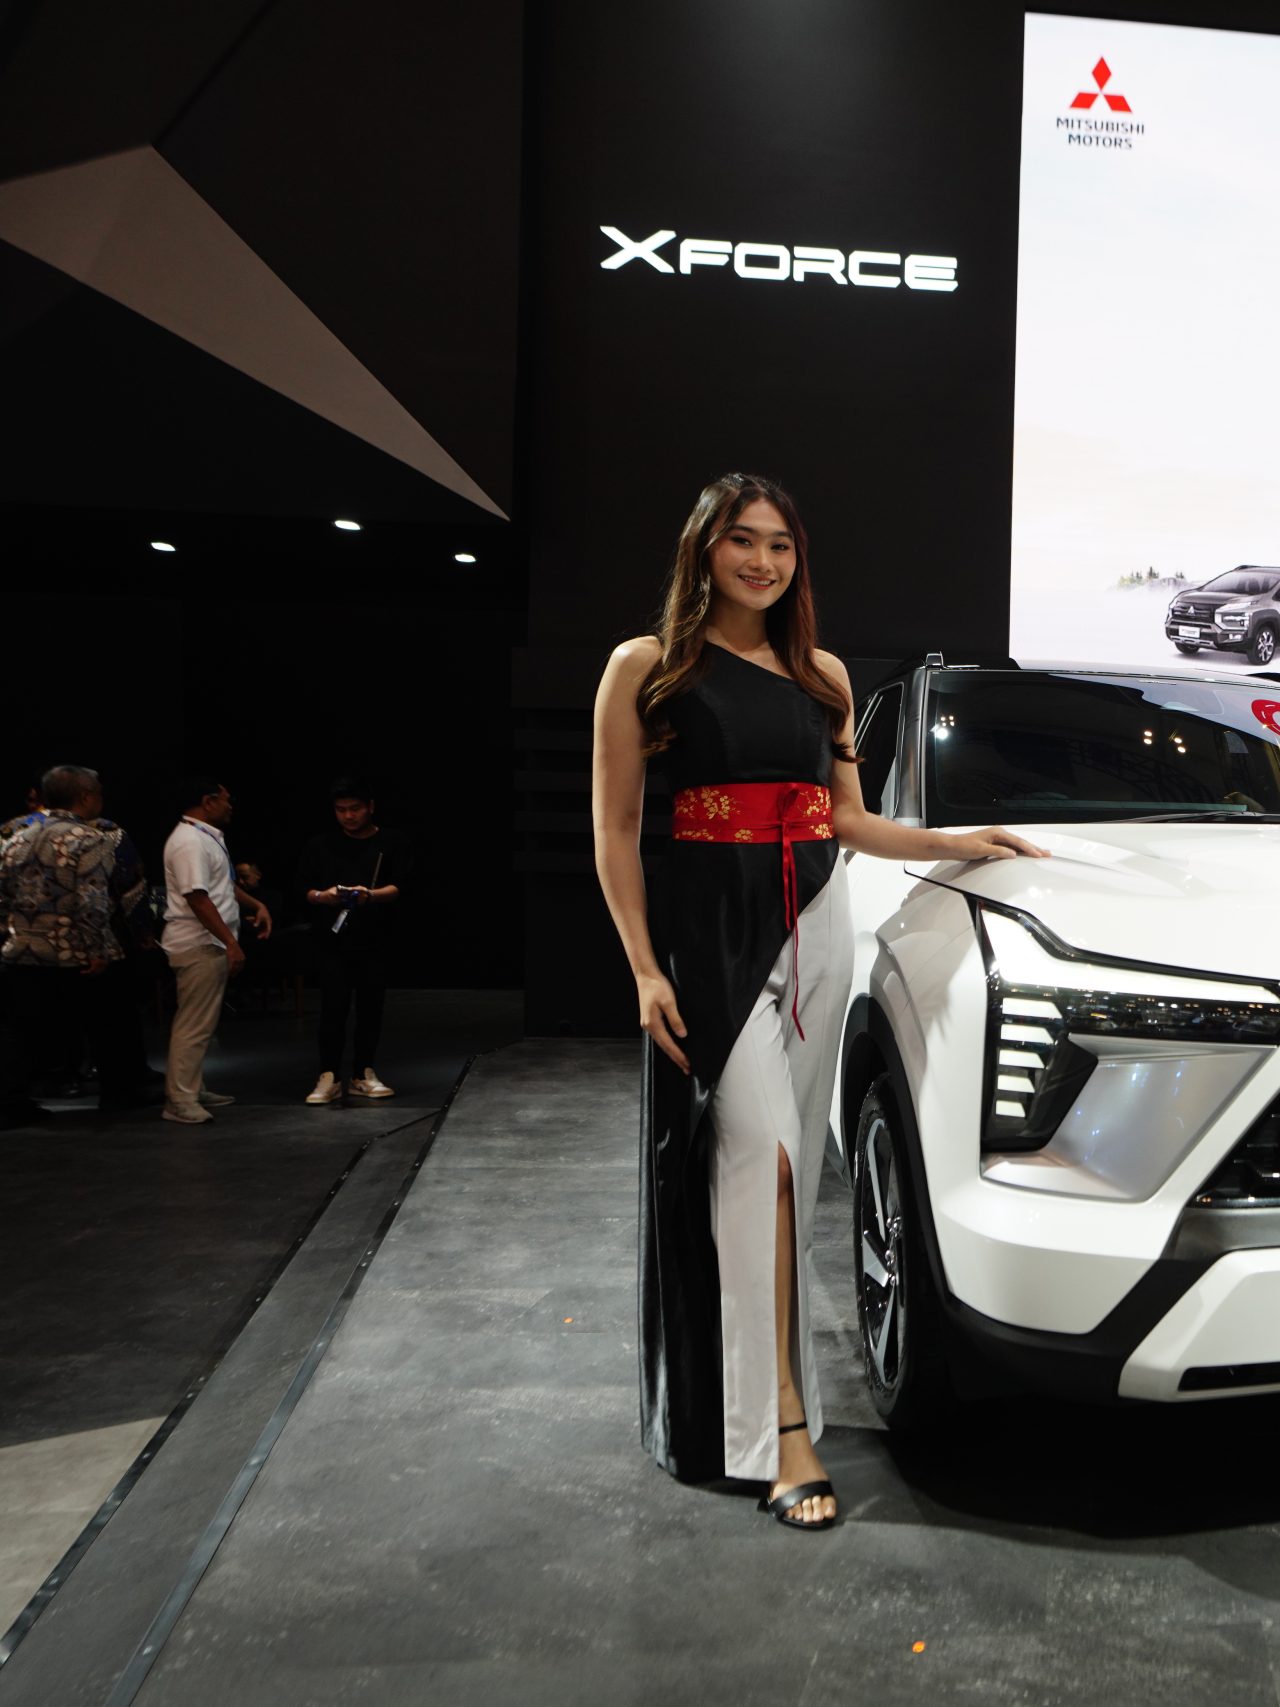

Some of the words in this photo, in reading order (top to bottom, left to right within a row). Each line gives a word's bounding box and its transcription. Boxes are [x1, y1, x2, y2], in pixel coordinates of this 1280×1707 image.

[1056, 117, 1144, 135] MITSUBISHI
[1068, 133, 1132, 149] MOTORS
[600, 225, 958, 292] XFORCE
